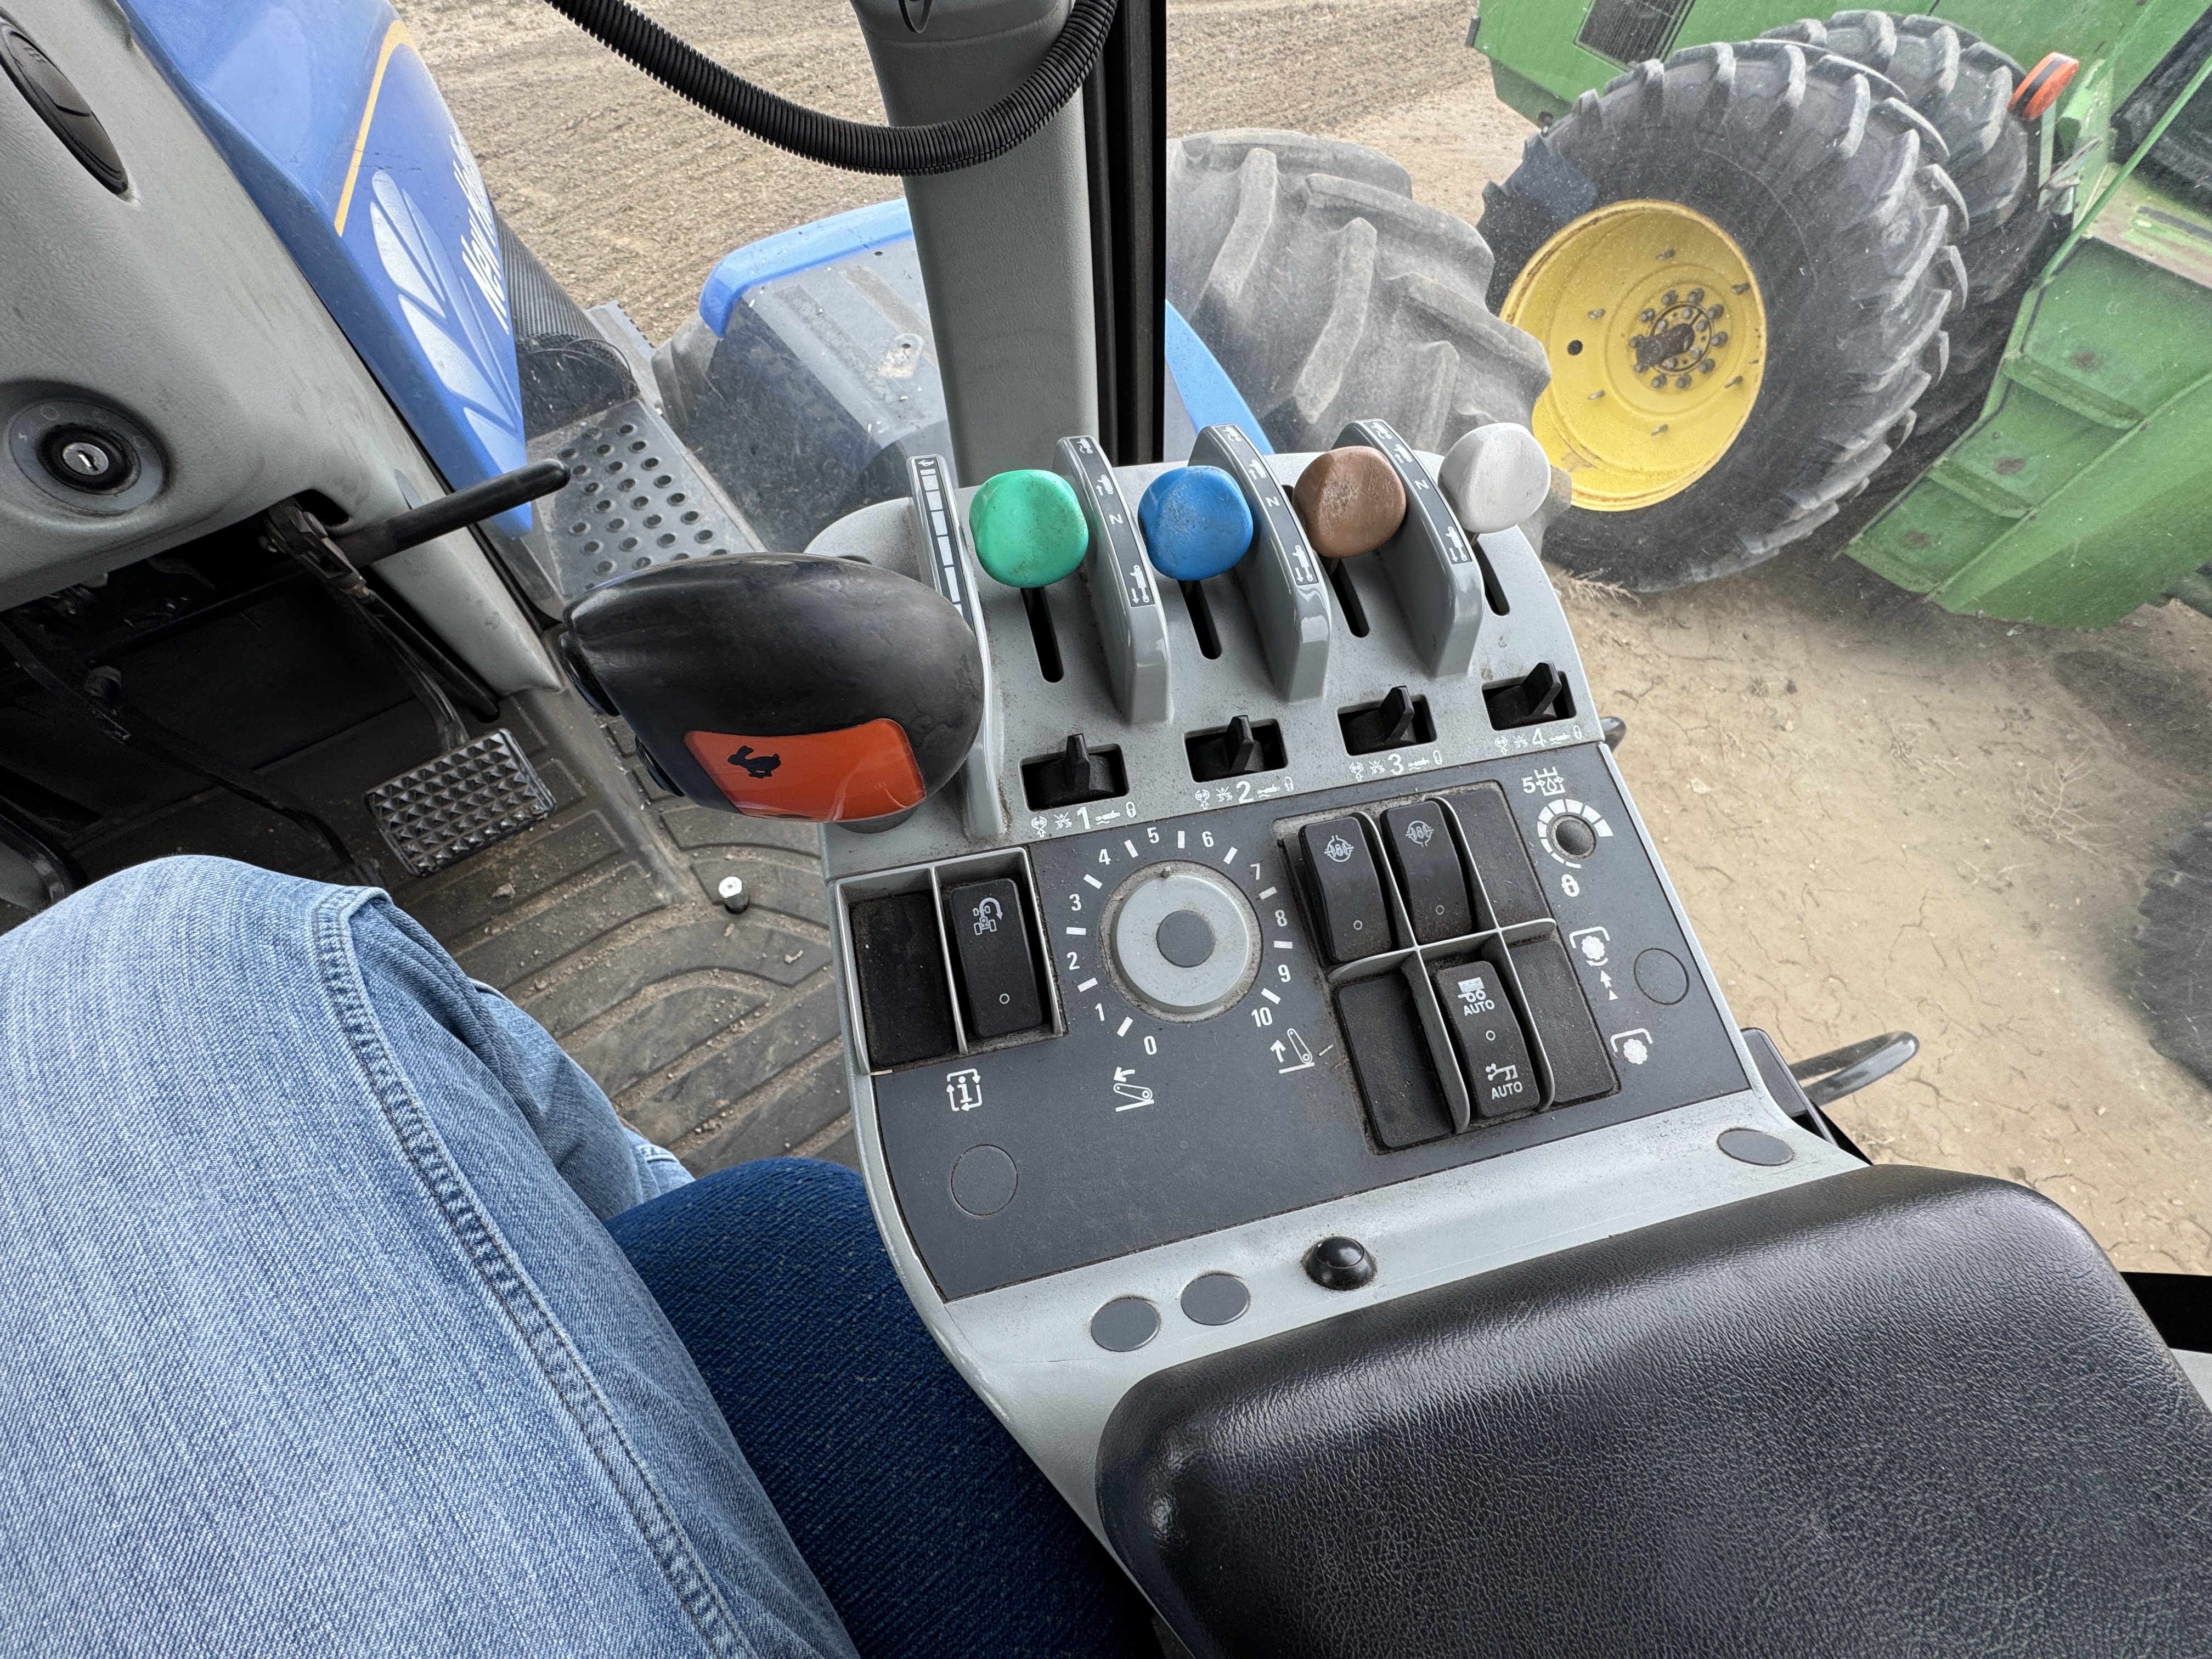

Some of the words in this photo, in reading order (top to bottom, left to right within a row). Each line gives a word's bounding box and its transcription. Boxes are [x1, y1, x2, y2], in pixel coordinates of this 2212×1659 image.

[1414, 479, 1430, 490] N
[1265, 496, 1280, 507] N
[1109, 514, 1124, 525] N
[1532, 727, 1547, 748] 4
[1388, 753, 1404, 775] 3
[1236, 781, 1254, 804] 2
[1522, 776, 1535, 794] 5
[1076, 806, 1091, 830] 1
[1147, 827, 1160, 844] 5
[1201, 831, 1214, 848] 6
[1099, 848, 1111, 865] 4
[1250, 862, 1261, 881] 7
[1069, 893, 1082, 911] 3
[1274, 910, 1288, 927] 8
[1066, 951, 1080, 970] 2
[1278, 964, 1291, 983] 9
[1095, 1003, 1105, 1022] 1
[1251, 1007, 1273, 1028] 10
[1463, 999, 1495, 1017] AUTO
[1143, 1036, 1157, 1055] 0
[1491, 1081, 1523, 1100] AUTO
